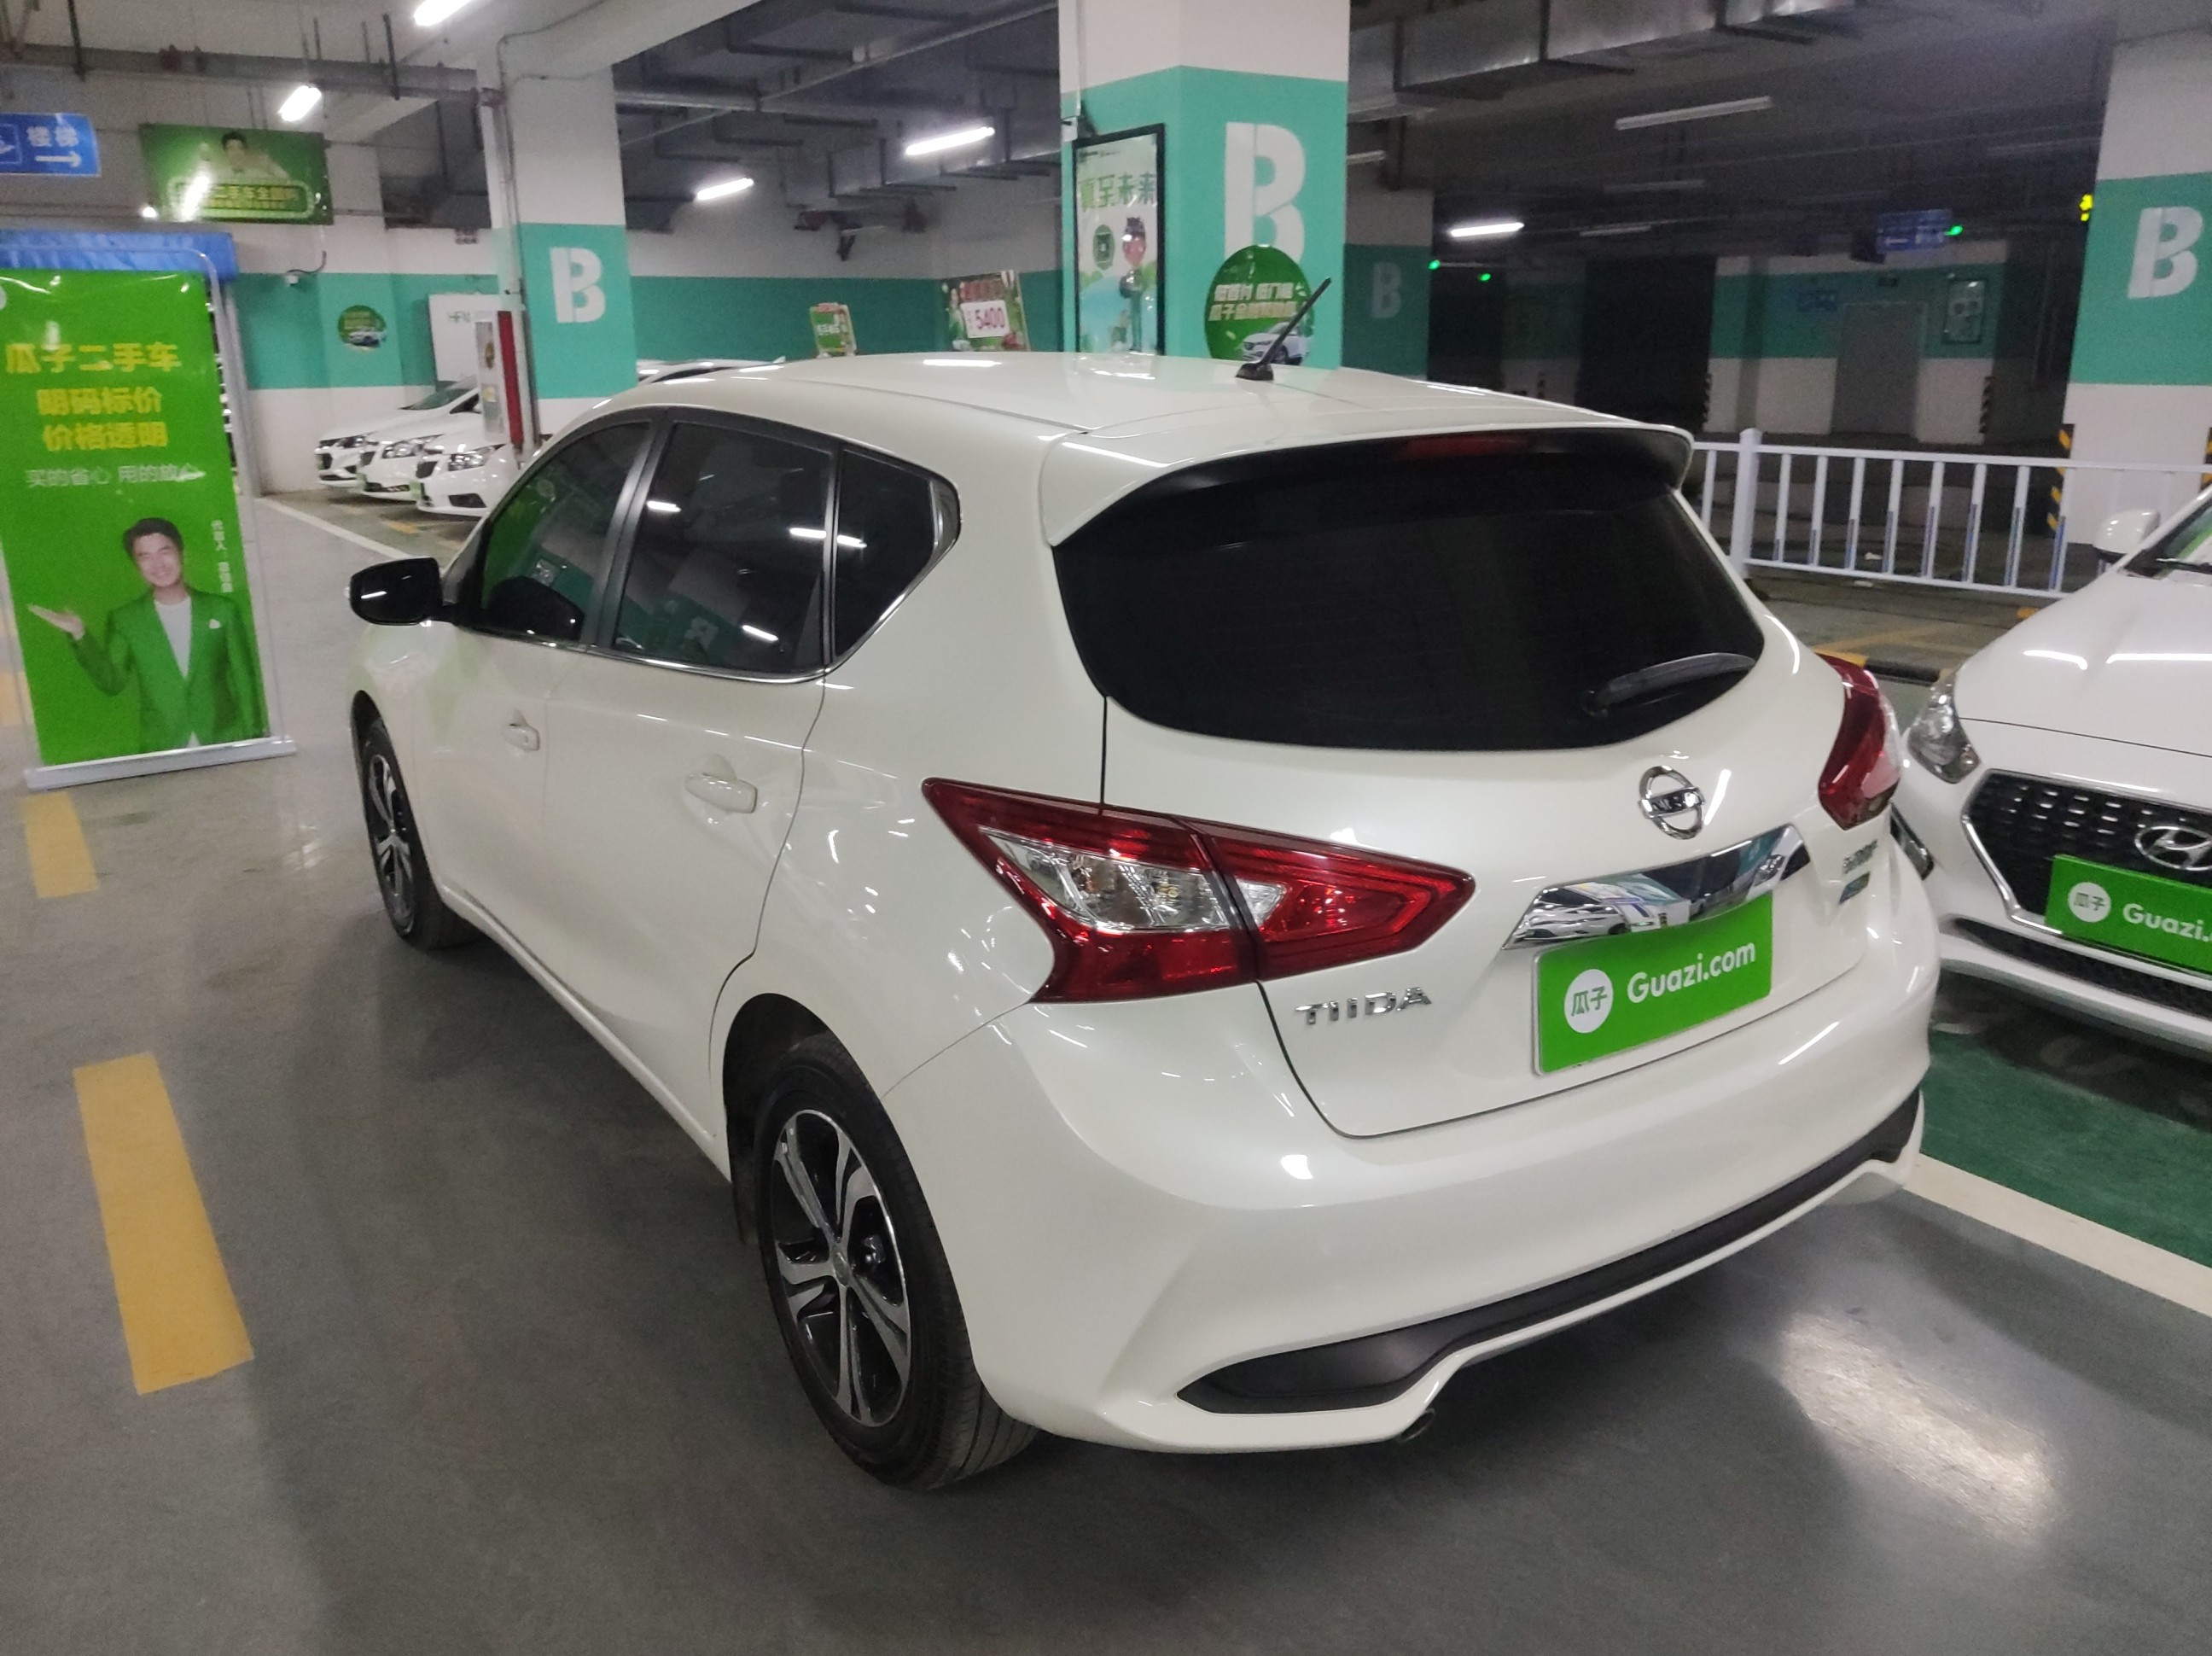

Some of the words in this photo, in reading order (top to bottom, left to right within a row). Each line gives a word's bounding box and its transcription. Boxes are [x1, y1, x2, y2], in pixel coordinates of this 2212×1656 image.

[1225, 122, 1306, 263] B
[2128, 206, 2203, 300] B
[550, 247, 606, 324] B
[1371, 261, 1401, 319] B
[6, 341, 182, 373] 瓜子二手车
[37, 387, 162, 415] 明码标价
[2122, 902, 2212, 942] Guazi.
[1627, 942, 1755, 1004] Guazi.com
[1295, 986, 1432, 1025] TIIDA
[1571, 986, 1608, 1017] 瓜子
